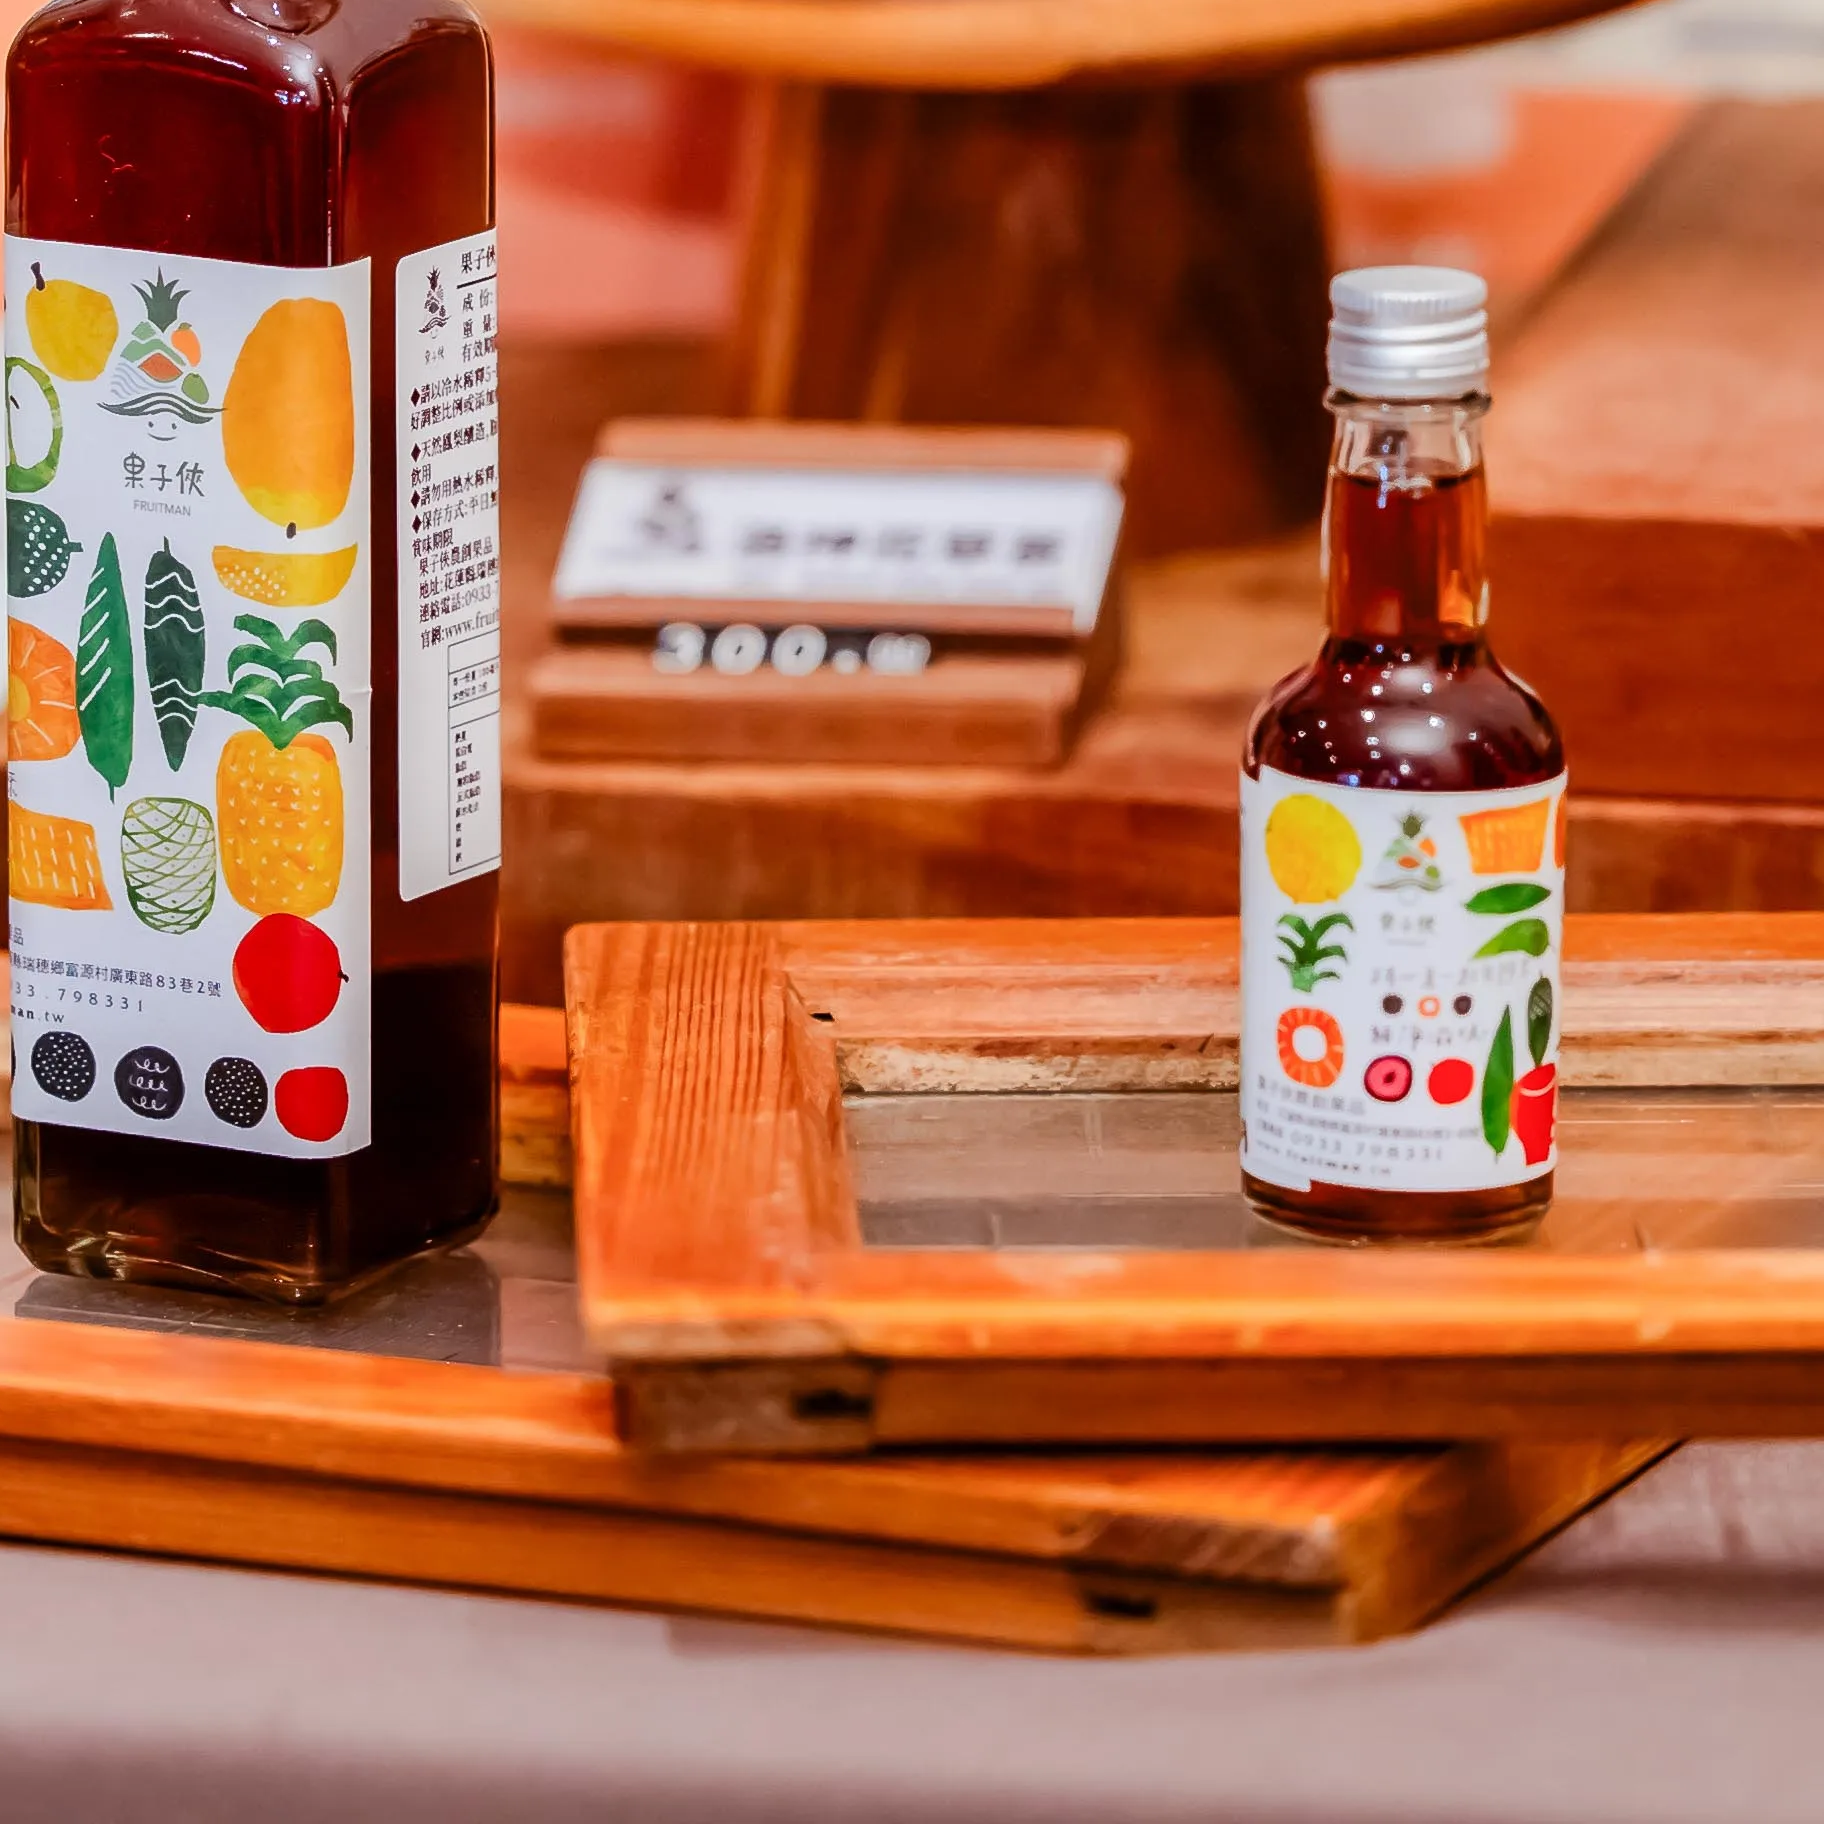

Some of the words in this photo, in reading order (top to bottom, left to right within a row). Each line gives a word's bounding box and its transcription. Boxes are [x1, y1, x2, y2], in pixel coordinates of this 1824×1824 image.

[410, 388, 498, 432] 好調整比例或添加
[123, 451, 205, 497] 果子俠
[133, 499, 191, 517] FRUITMAN
